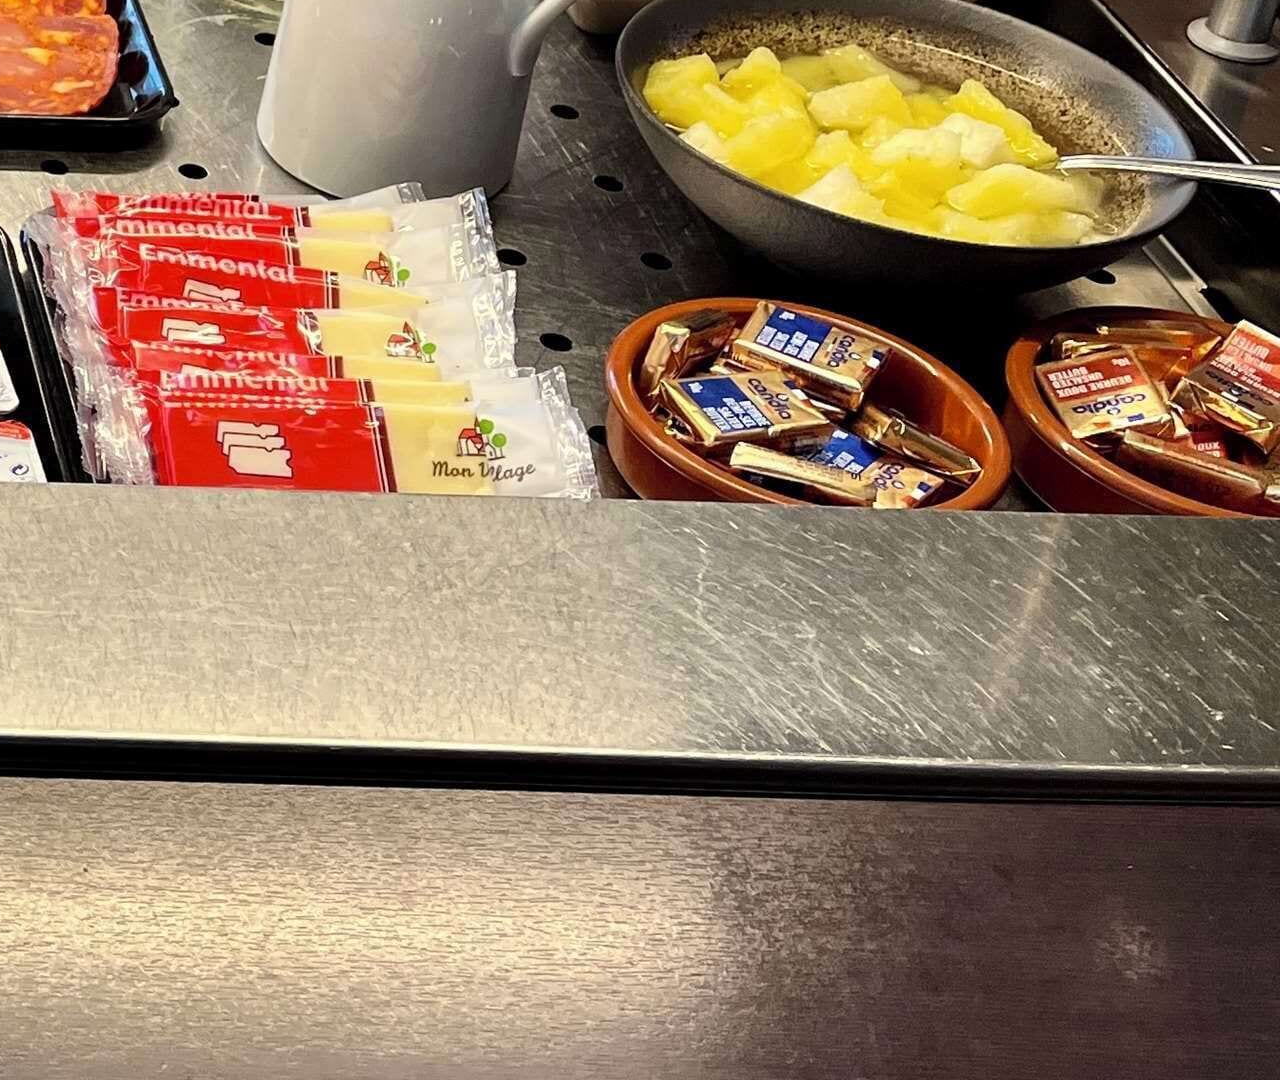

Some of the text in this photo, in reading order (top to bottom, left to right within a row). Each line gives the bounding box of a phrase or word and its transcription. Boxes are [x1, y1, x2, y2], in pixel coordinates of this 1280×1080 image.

[100, 215, 257, 238] Emmental
[139, 242, 298, 284] Emmental
[1047, 366, 1089, 382] BUTTER
[1051, 371, 1104, 389] UNSALTED
[1055, 375, 1133, 398] BEURRE DOUX
[748, 377, 791, 420] candia
[1071, 393, 1147, 415] candia
[431, 460, 476, 477] Mon
